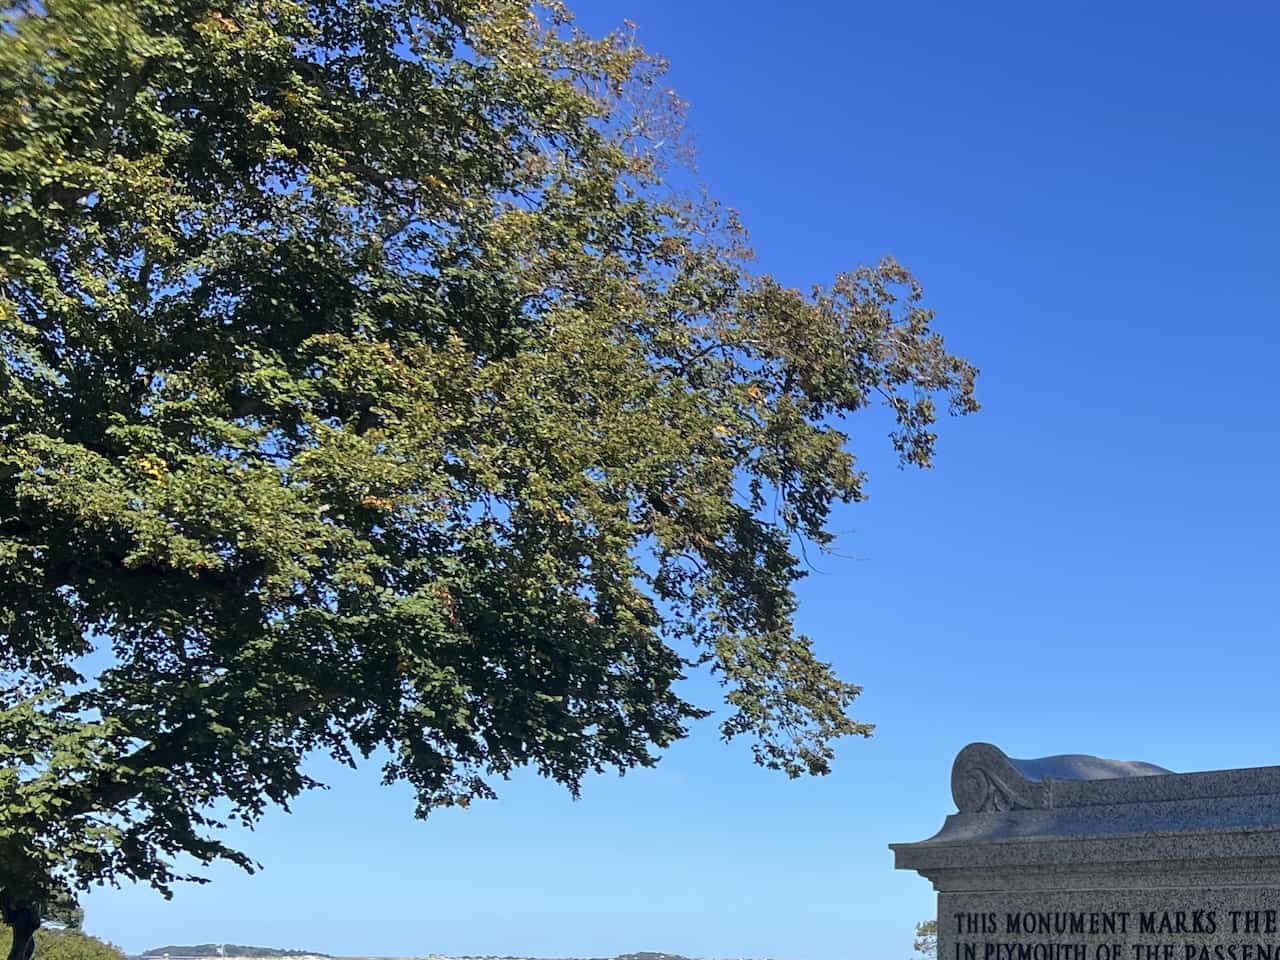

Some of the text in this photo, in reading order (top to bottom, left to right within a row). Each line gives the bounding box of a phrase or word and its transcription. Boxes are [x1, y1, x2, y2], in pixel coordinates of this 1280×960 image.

[952, 911, 997, 934] THIS
[1005, 910, 1130, 934] MONUMENT
[1138, 909, 1217, 934] MARKS
[1227, 908, 1277, 934] THE
